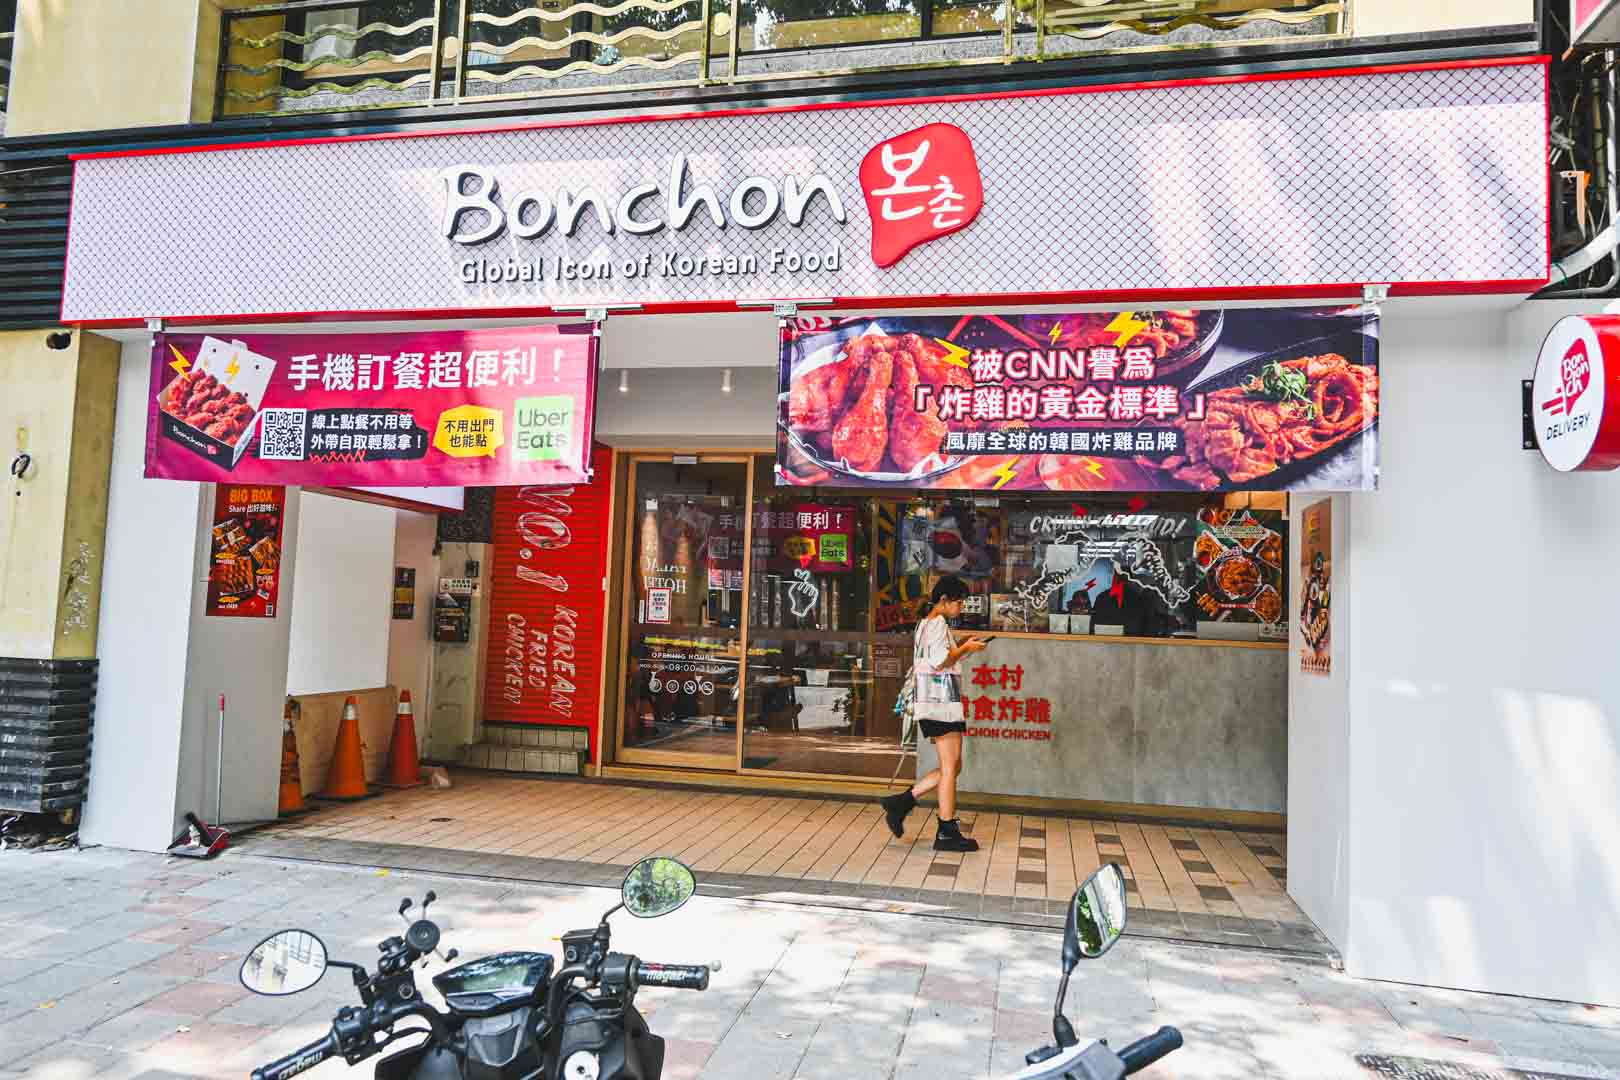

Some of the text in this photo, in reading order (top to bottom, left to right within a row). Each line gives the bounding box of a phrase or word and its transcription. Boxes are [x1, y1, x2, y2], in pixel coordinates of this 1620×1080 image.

[870, 139, 965, 229] 본촌
[442, 151, 846, 244] Bonchon
[460, 246, 841, 283] Global Icon of Korean Food
[287, 346, 564, 391] 手機訂餐超便利！
[311, 413, 414, 430] 線上點餐不用等
[444, 418, 495, 433] 不用出門
[518, 407, 569, 428] Uber
[1546, 412, 1591, 440] DELIVERY
[310, 433, 422, 451] 外帶自取輕鬆拿！
[449, 433, 487, 448] 也能點
[517, 430, 567, 449] Eats
[946, 431, 1178, 451] 風靡全球的韓國炸雞品牌
[230, 488, 273, 503] BIG BOX
[504, 612, 527, 704] CHICKEN
[528, 628, 548, 690] FRIED
[550, 603, 578, 718] KOREAN
[971, 663, 1025, 691] 本村
[1001, 729, 1052, 741] CHICKEN
